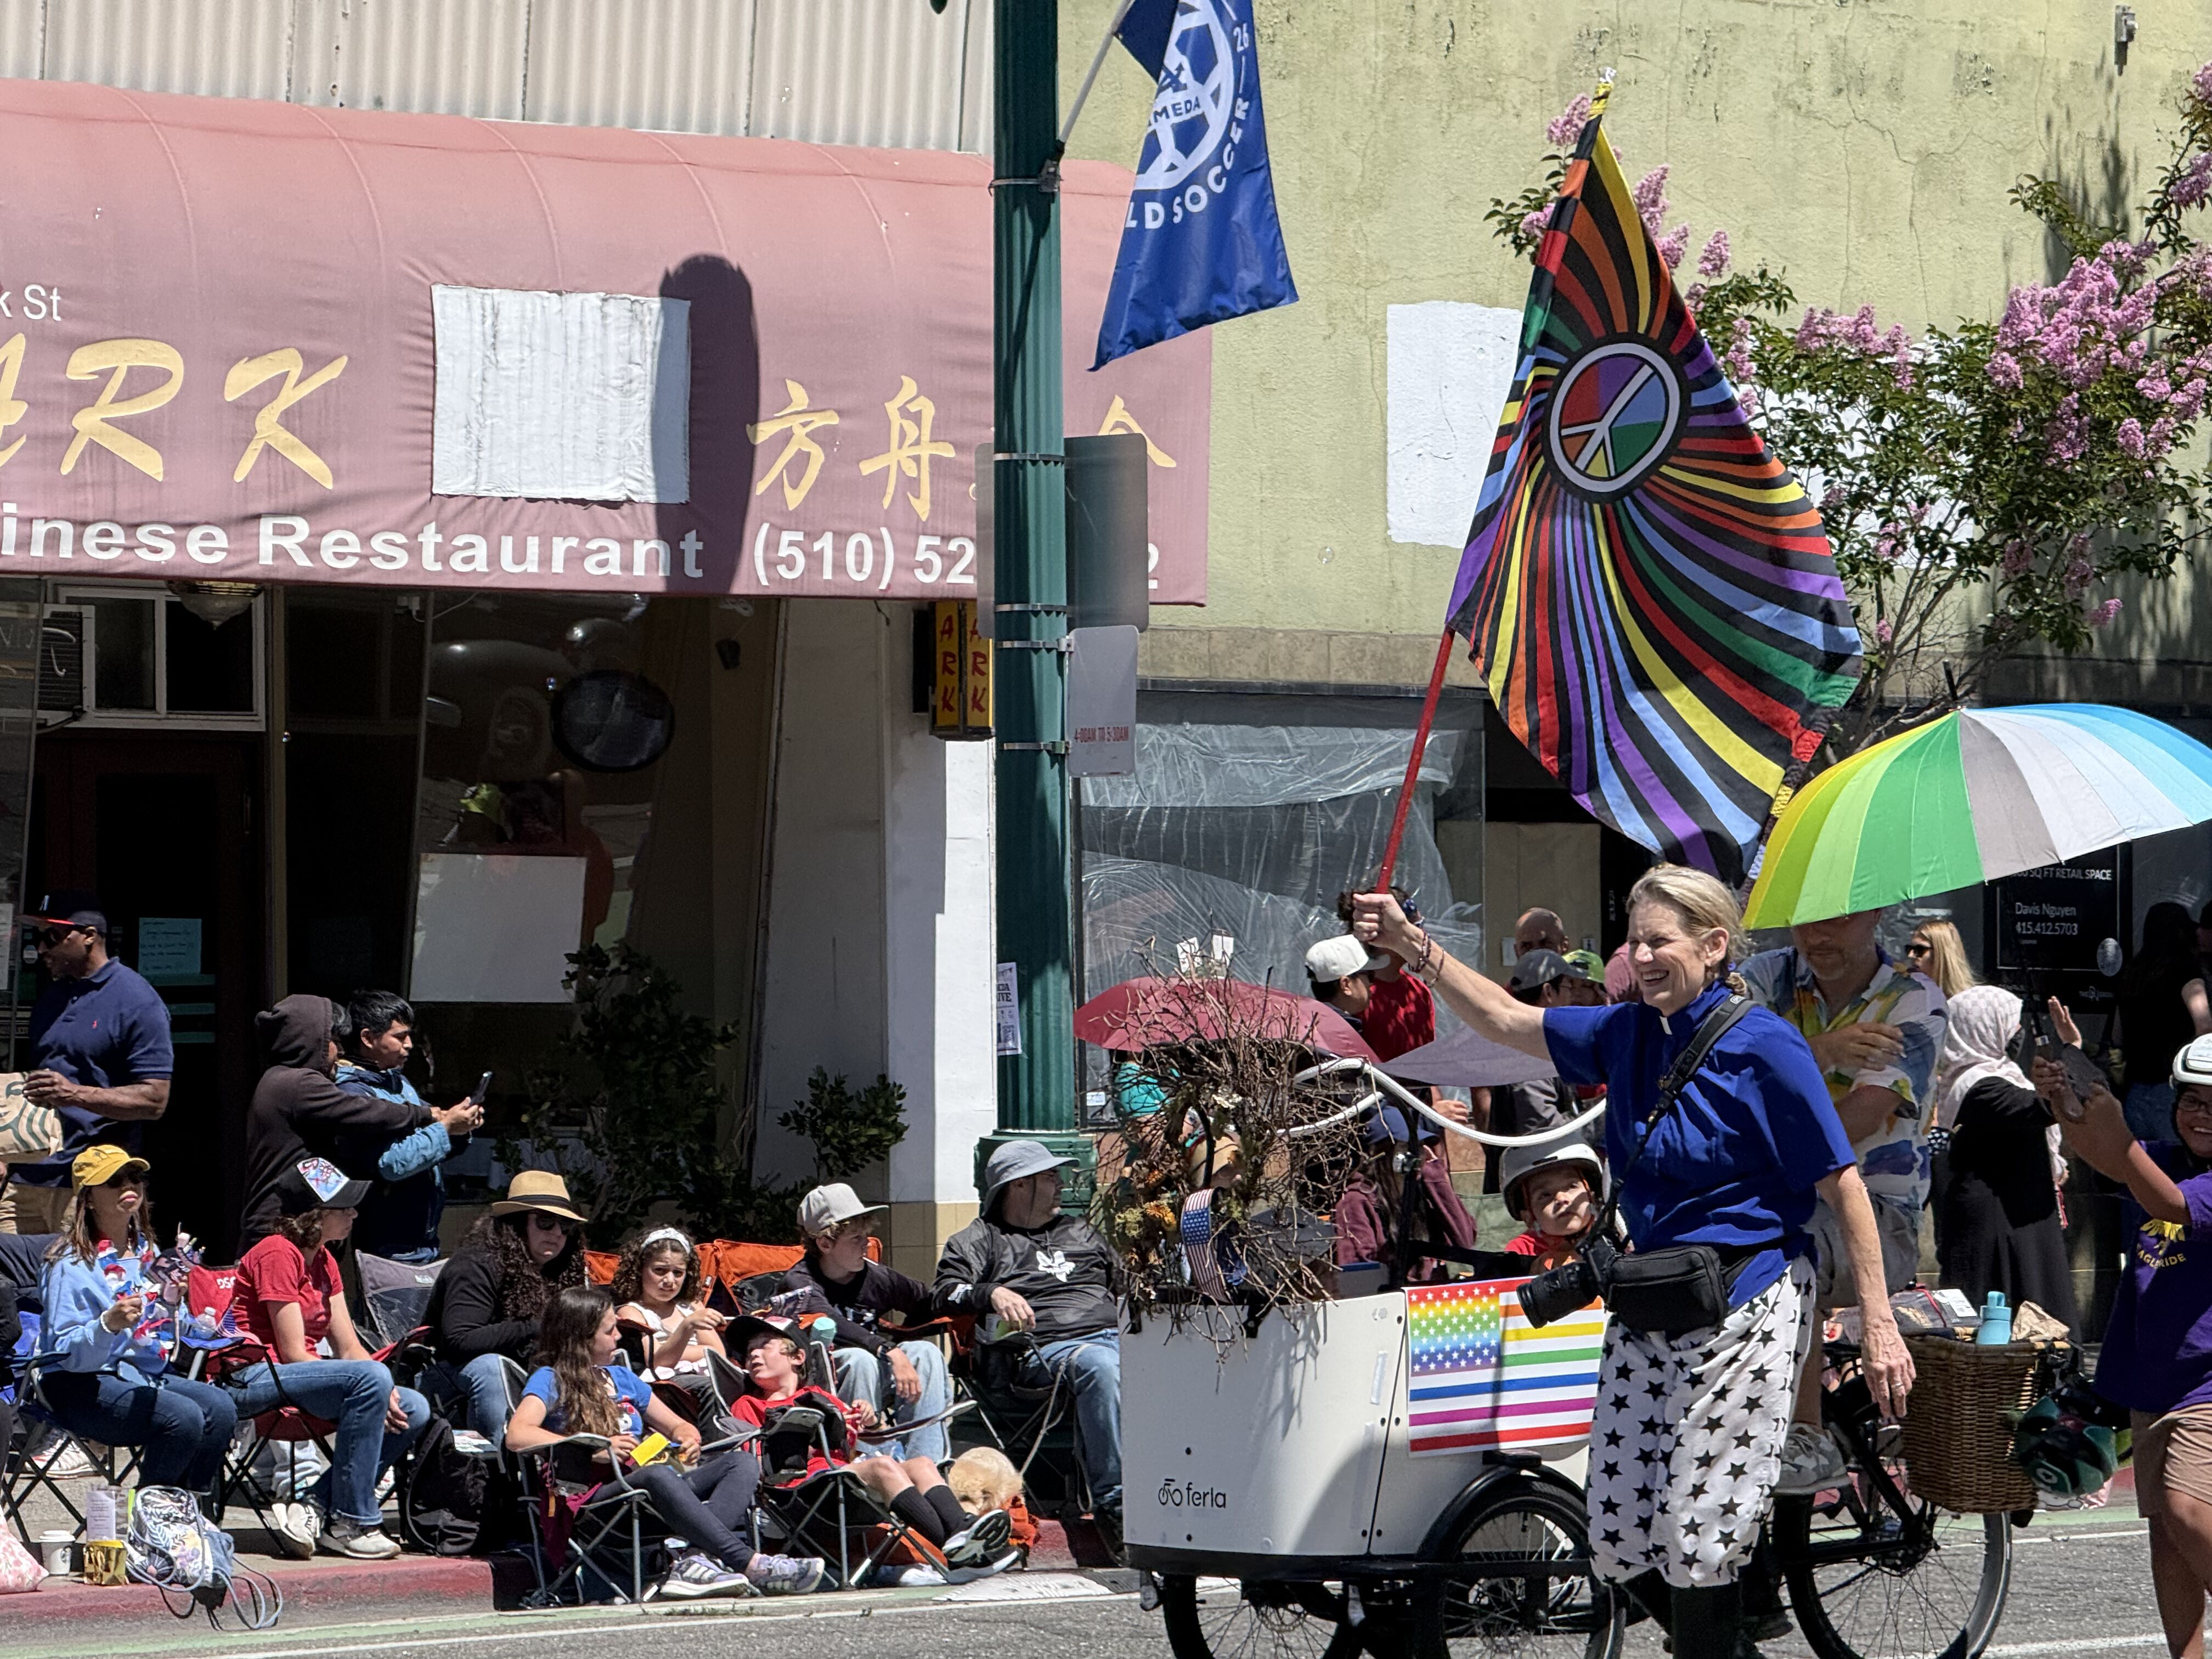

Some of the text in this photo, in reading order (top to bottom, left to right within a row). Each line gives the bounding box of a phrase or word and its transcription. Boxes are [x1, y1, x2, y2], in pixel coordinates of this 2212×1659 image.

[1233, 23, 1249, 52] 26
[1149, 95, 1200, 126] MEDA
[1173, 98, 1250, 224] SOCCER
[23, 284, 61, 321] St
[2, 502, 229, 564] inese
[258, 513, 703, 578] Restaurant
[754, 522, 894, 590] (510)
[940, 614, 957, 713] ARK
[2043, 868, 2055, 878] FT
[2056, 868, 2084, 879] RETAIL
[2085, 869, 2112, 881] SPACE
[2015, 902, 2076, 918] Davis Nguyen
[1186, 1482, 1227, 1509] ferla
